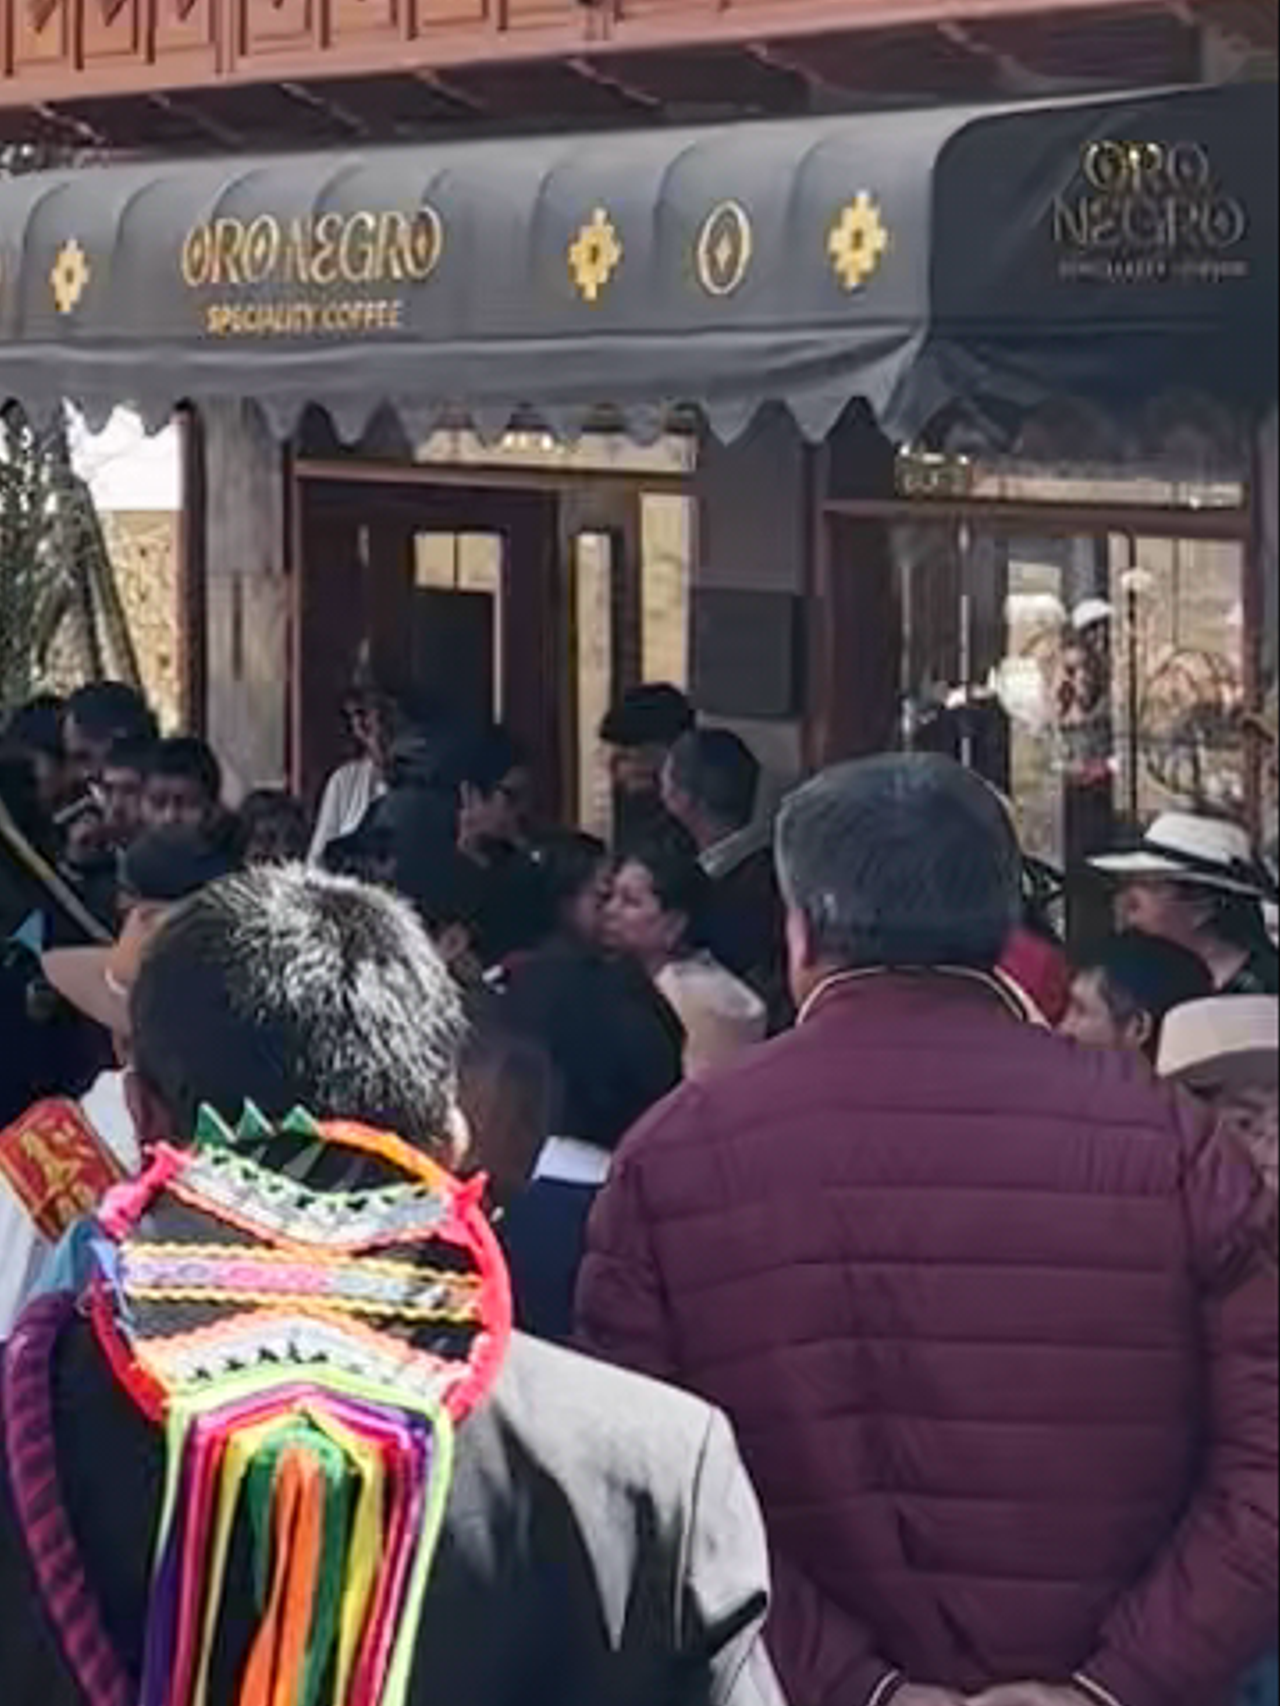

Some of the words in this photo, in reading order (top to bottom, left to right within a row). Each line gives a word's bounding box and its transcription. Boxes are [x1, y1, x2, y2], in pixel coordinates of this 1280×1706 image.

[1083, 141, 1209, 189] ORO
[181, 212, 280, 286] ORO
[287, 205, 441, 284] NEGRO
[1051, 195, 1246, 250] NEGRO
[207, 303, 316, 333] SPECIALITY
[322, 299, 403, 329] COFFEE
